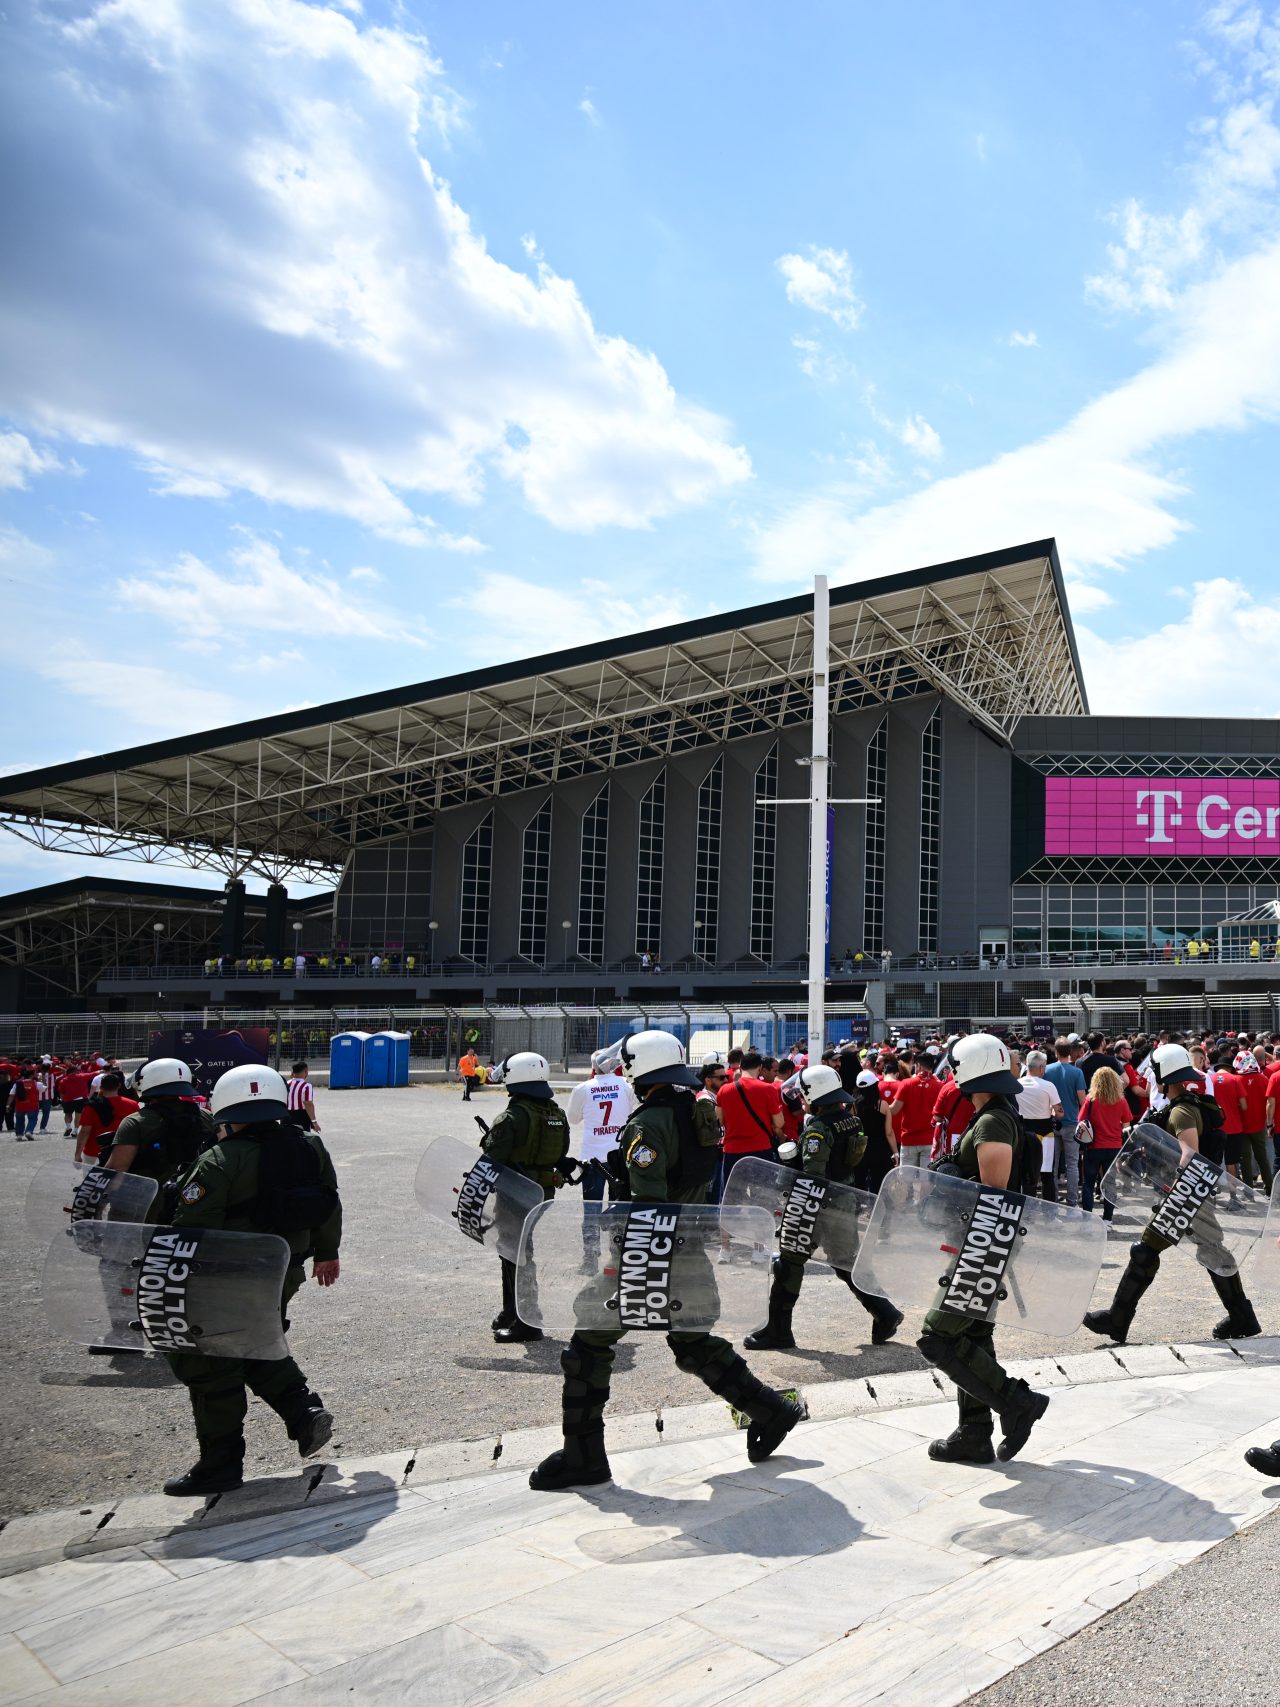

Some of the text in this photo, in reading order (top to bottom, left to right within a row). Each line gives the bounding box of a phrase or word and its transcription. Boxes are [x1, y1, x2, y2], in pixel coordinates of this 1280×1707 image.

[590, 1085, 619, 1094] SPANOULIS
[599, 1101, 613, 1126] 7
[833, 1116, 860, 1133] POLICE
[593, 1125, 621, 1136] PIRAEUS
[470, 1169, 500, 1240] POLICE
[797, 1185, 826, 1255] POLICE
[1167, 1169, 1219, 1241] POLICE
[646, 1215, 677, 1324] POLICE
[968, 1202, 1022, 1312] POLICE
[165, 1241, 198, 1348] POLICE
